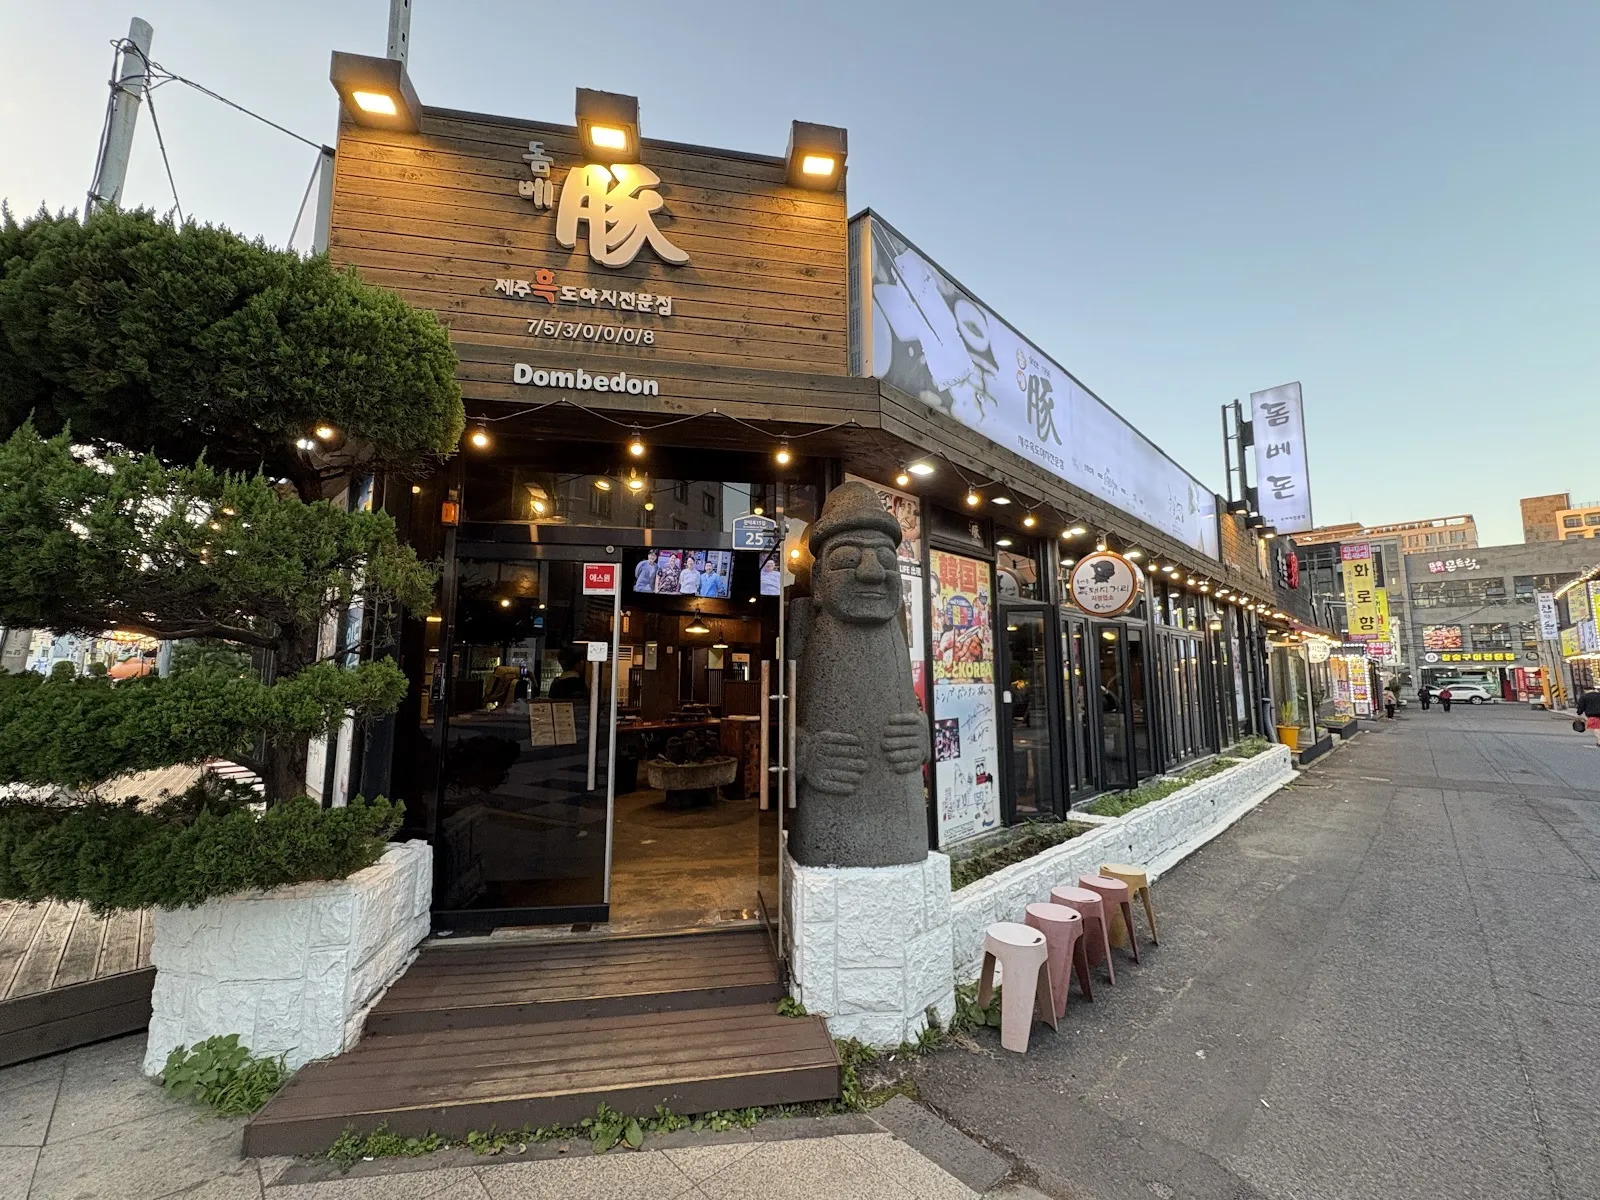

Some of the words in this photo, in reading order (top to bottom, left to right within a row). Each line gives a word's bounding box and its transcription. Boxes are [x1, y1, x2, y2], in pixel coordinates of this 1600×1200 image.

[526, 318, 655, 345] 7/5/3/0/0/0/8
[513, 362, 660, 397] Dombedon
[1259, 401, 1296, 500] 돔베돈
[745, 532, 764, 546] 25
[588, 573, 612, 583] 에스원
[1353, 562, 1376, 631] 화로향
